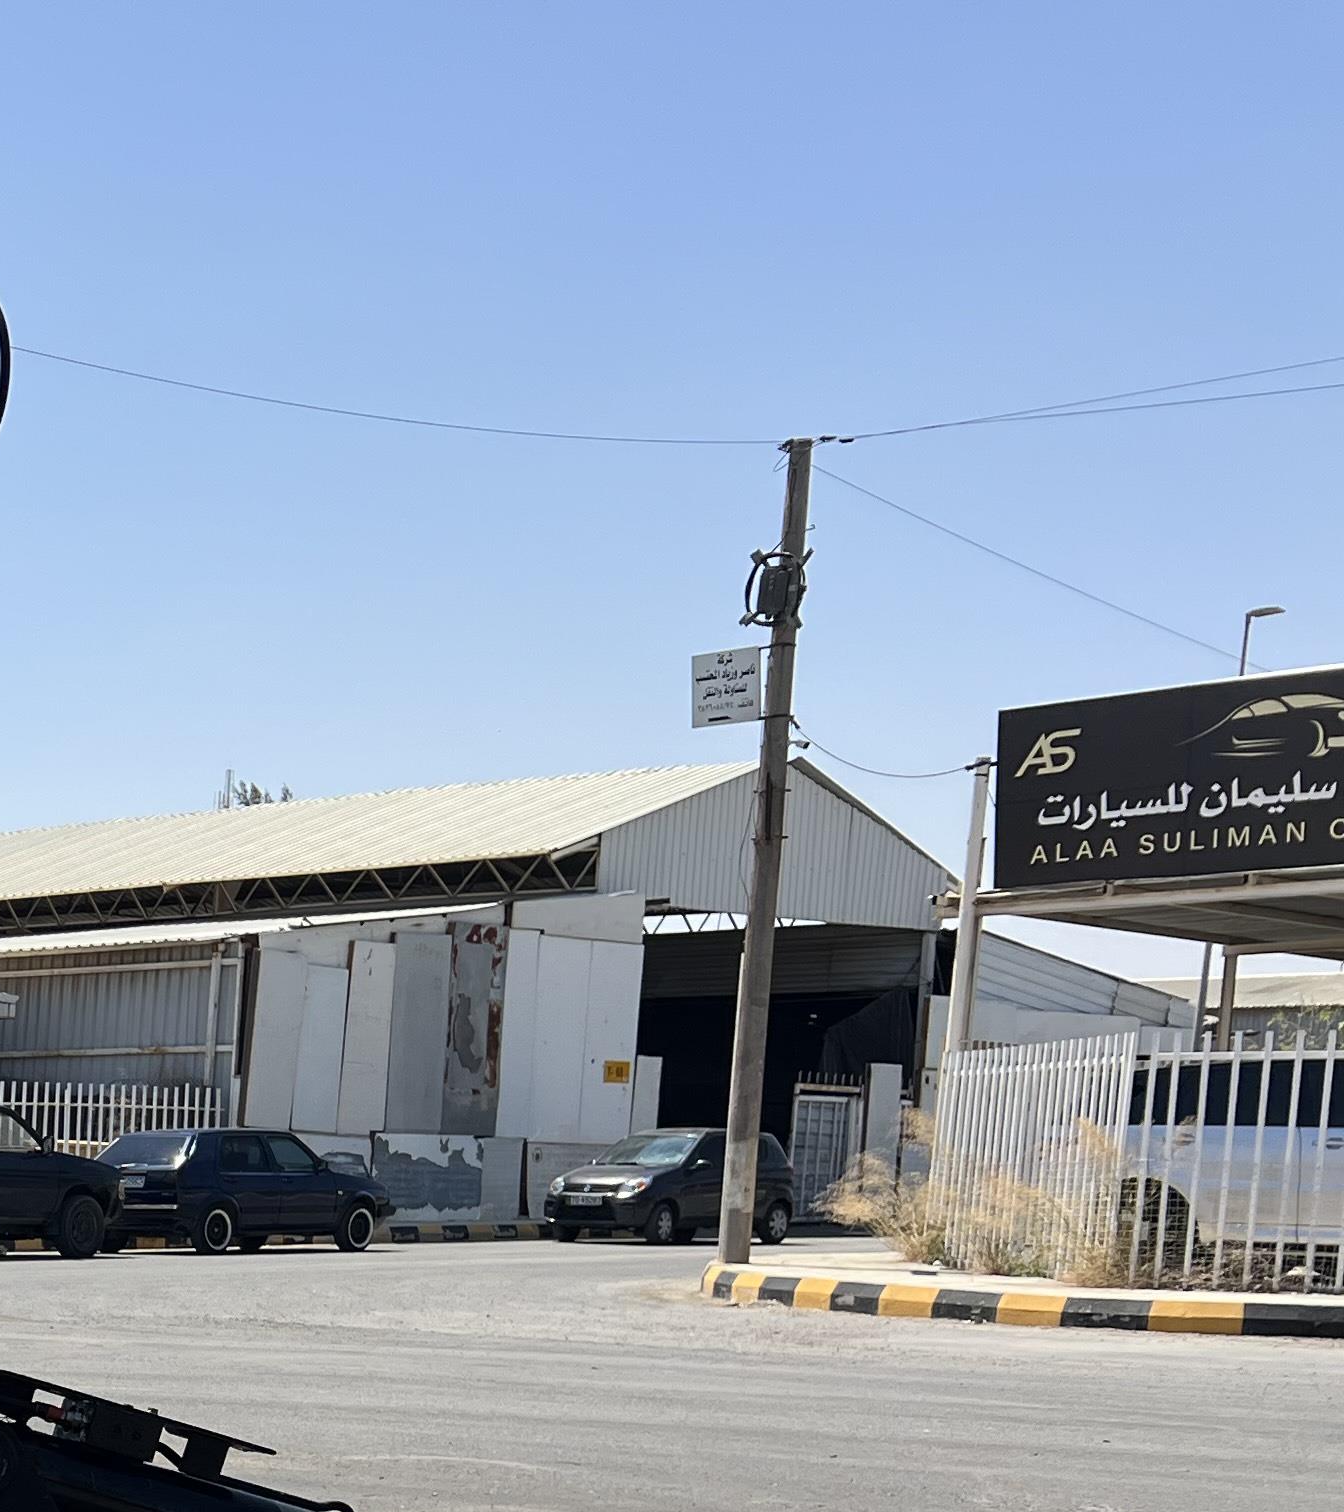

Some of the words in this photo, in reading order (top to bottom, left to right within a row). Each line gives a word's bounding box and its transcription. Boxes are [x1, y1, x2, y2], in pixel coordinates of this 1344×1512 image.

[717, 652, 733, 666] شركة
[1036, 781, 1195, 831] للسيارات
[1199, 770, 1338, 818] سليمان
[1030, 838, 1119, 865] ALAA
[1138, 820, 1307, 855] SULIMAN
